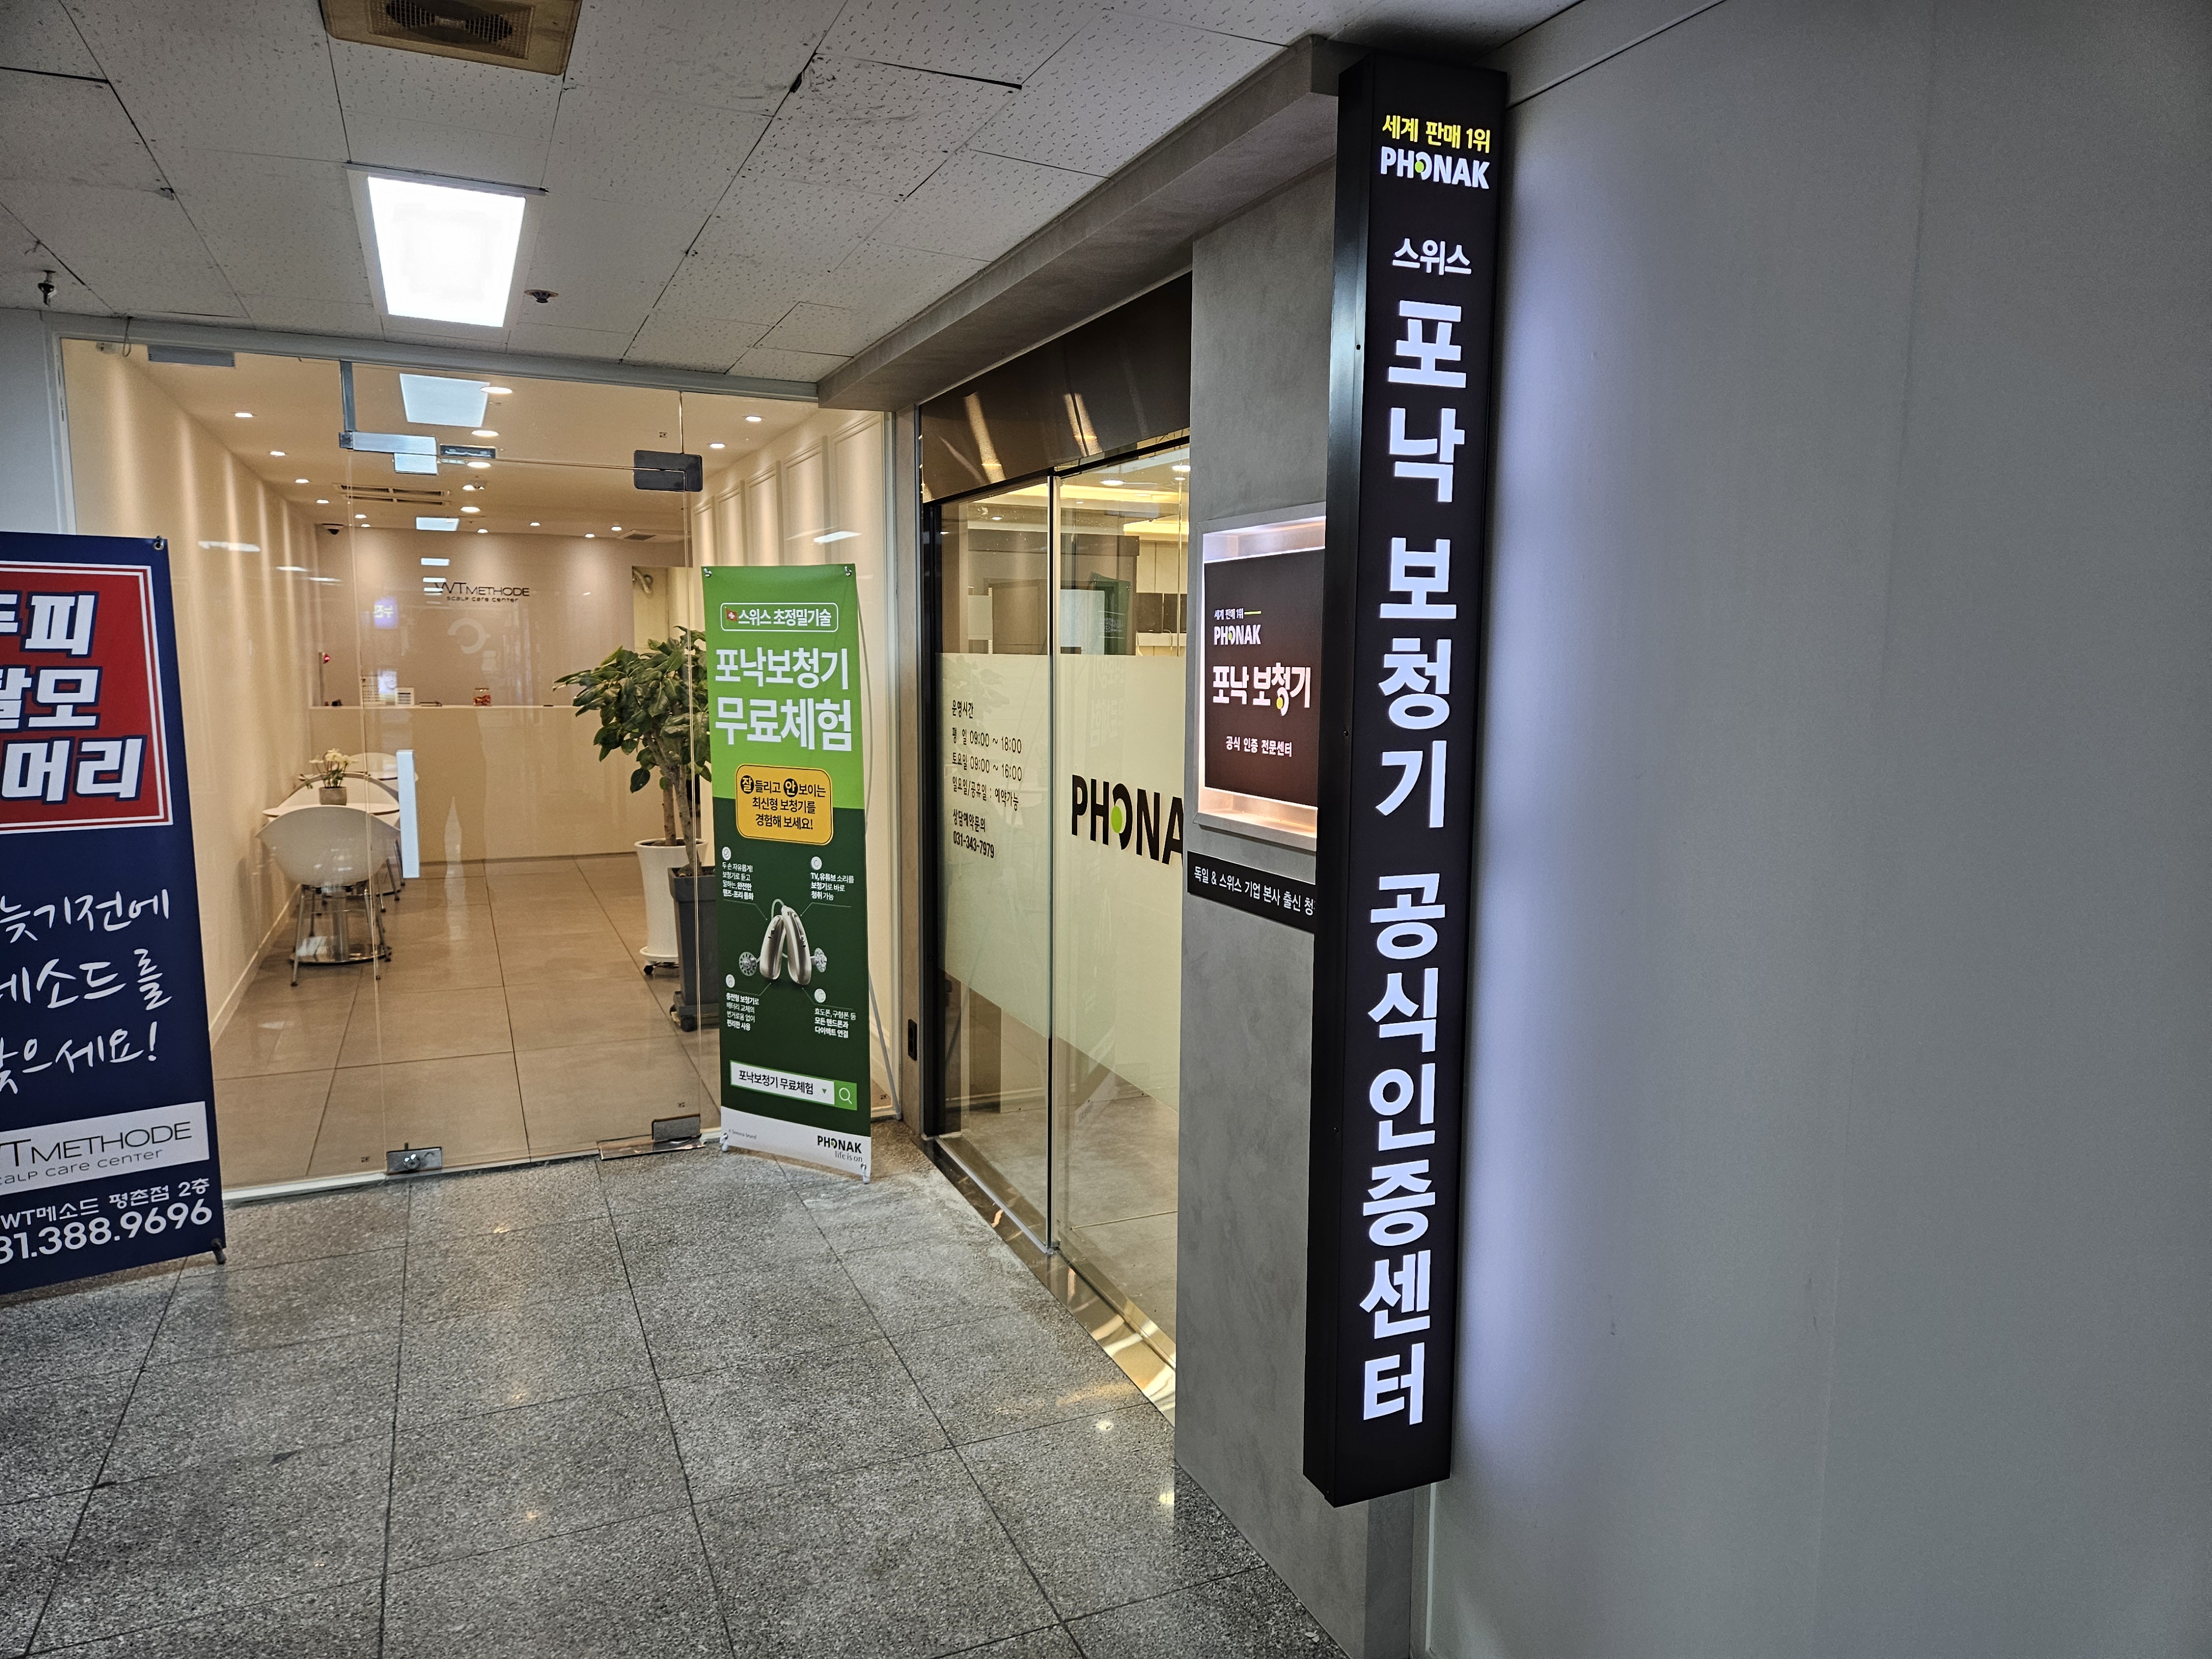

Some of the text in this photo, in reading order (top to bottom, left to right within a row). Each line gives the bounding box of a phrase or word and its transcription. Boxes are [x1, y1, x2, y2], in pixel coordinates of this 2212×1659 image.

[1383, 115, 1490, 153] 세계 판매 1위
[1381, 146, 1490, 189] PHONAK
[1392, 238, 1472, 275] 스위스
[1388, 300, 1466, 502] 포낙
[738, 608, 832, 627] 스위스 초정밀기술
[1236, 608, 1244, 619] 1위
[1214, 624, 1261, 645] PHONAK
[715, 647, 848, 690] 포낙보청기
[1213, 662, 1311, 716] 포낙 보청기
[1375, 538, 1457, 828] 보청기
[952, 700, 973, 719] 운영시간
[715, 697, 852, 751] 무료체험
[970, 730, 989, 747] 09:00
[1001, 736, 1022, 754] 18:00
[1225, 736, 1292, 757] 공식 인증 전문센터
[1, 738, 143, 801] 머리
[952, 752, 967, 770] 토요일
[970, 755, 990, 774] 09:00
[1002, 763, 1022, 781] 16:00
[753, 797, 816, 814] 최신형 보청기를
[952, 776, 987, 801] 일요일/공휴일
[995, 788, 1019, 811] 예약가능
[756, 814, 813, 830] 경험해 보세요!
[953, 808, 985, 833] 상담예약문의
[953, 831, 994, 859] 031-343-7979
[723, 871, 740, 880] 보청기로
[811, 881, 833, 890] 보청기로
[837, 875, 854, 883] 소리를
[1194, 865, 1315, 916] 독일 & 스위스 기업 본사 출신 청
[0, 888, 169, 943] 늦기전에
[740, 995, 759, 1005] 보청기로
[741, 1022, 750, 1031] 사용
[815, 1017, 826, 1025] 모든
[837, 1030, 848, 1038] 연결
[739, 1070, 813, 1095] 포낙보청기 무료체험
[0, 1121, 192, 1167] TMETHODE
[817, 1135, 862, 1154] PHONAK
[835, 1151, 846, 1160] life
[45, 1162, 90, 1177] care
[1, 1178, 210, 1229] WT메소드 평촌점 2층
